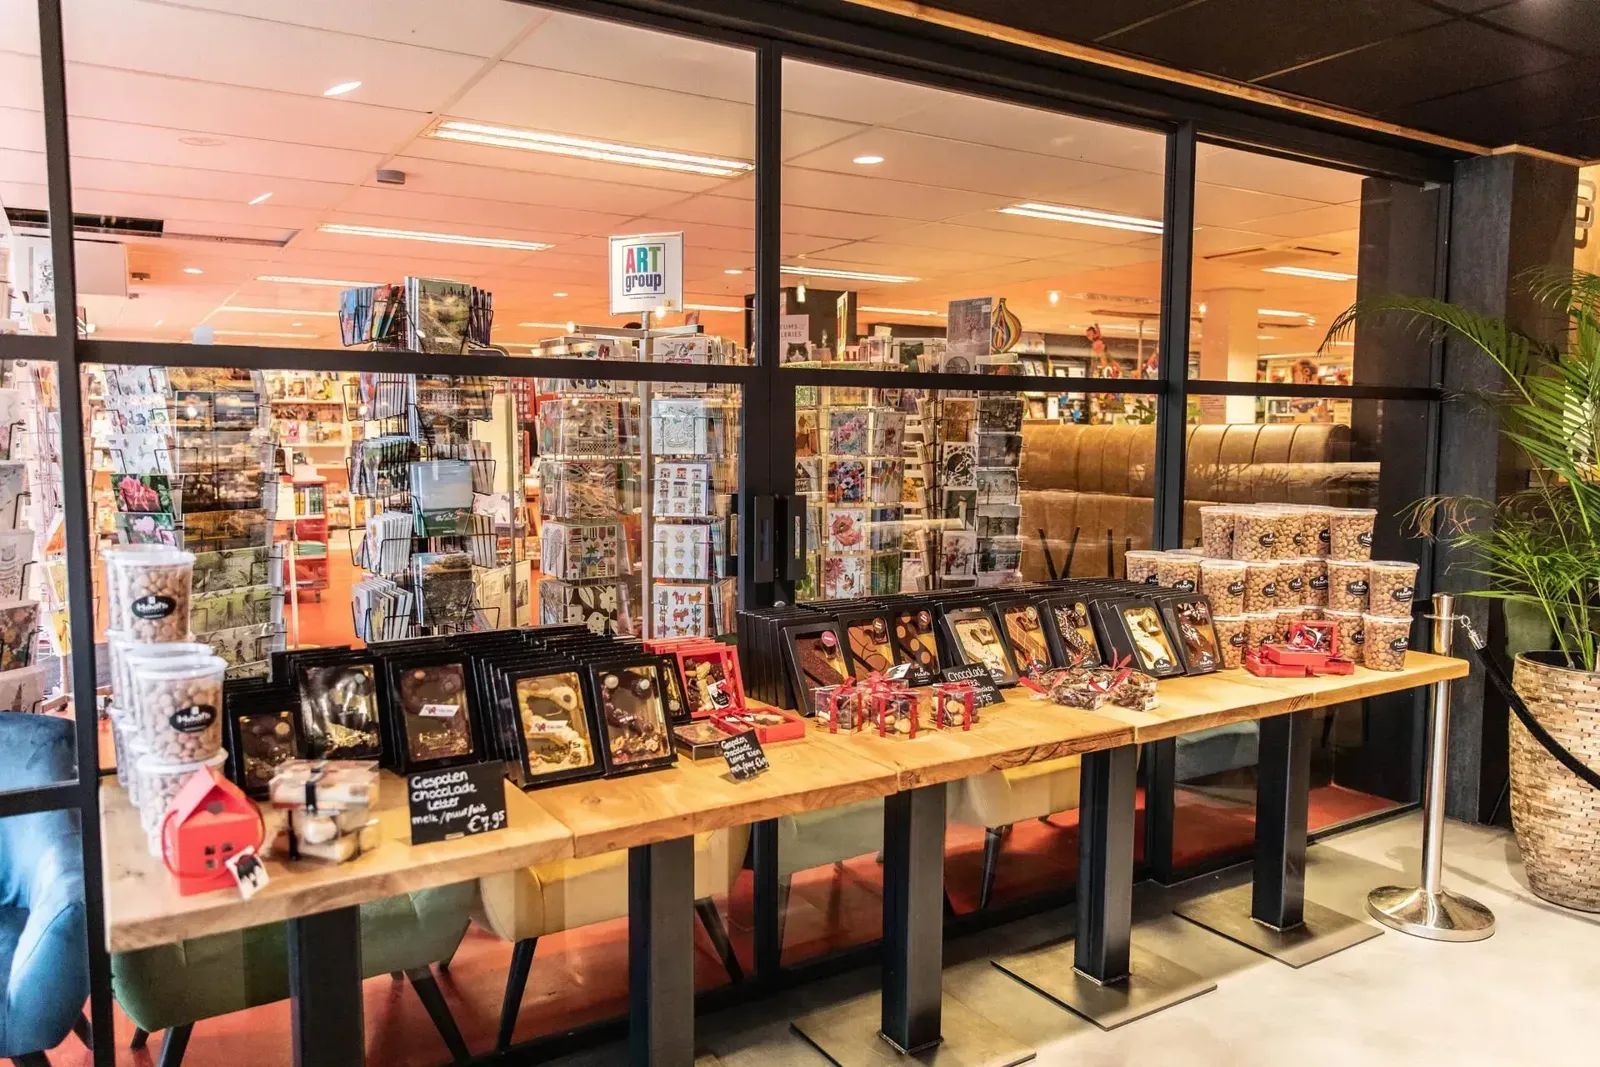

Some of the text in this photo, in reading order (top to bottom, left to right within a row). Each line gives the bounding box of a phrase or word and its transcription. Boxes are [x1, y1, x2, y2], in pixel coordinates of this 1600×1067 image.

[626, 247, 661, 273] ART
[626, 274, 661, 292] group
[947, 667, 988, 682] Chocolade
